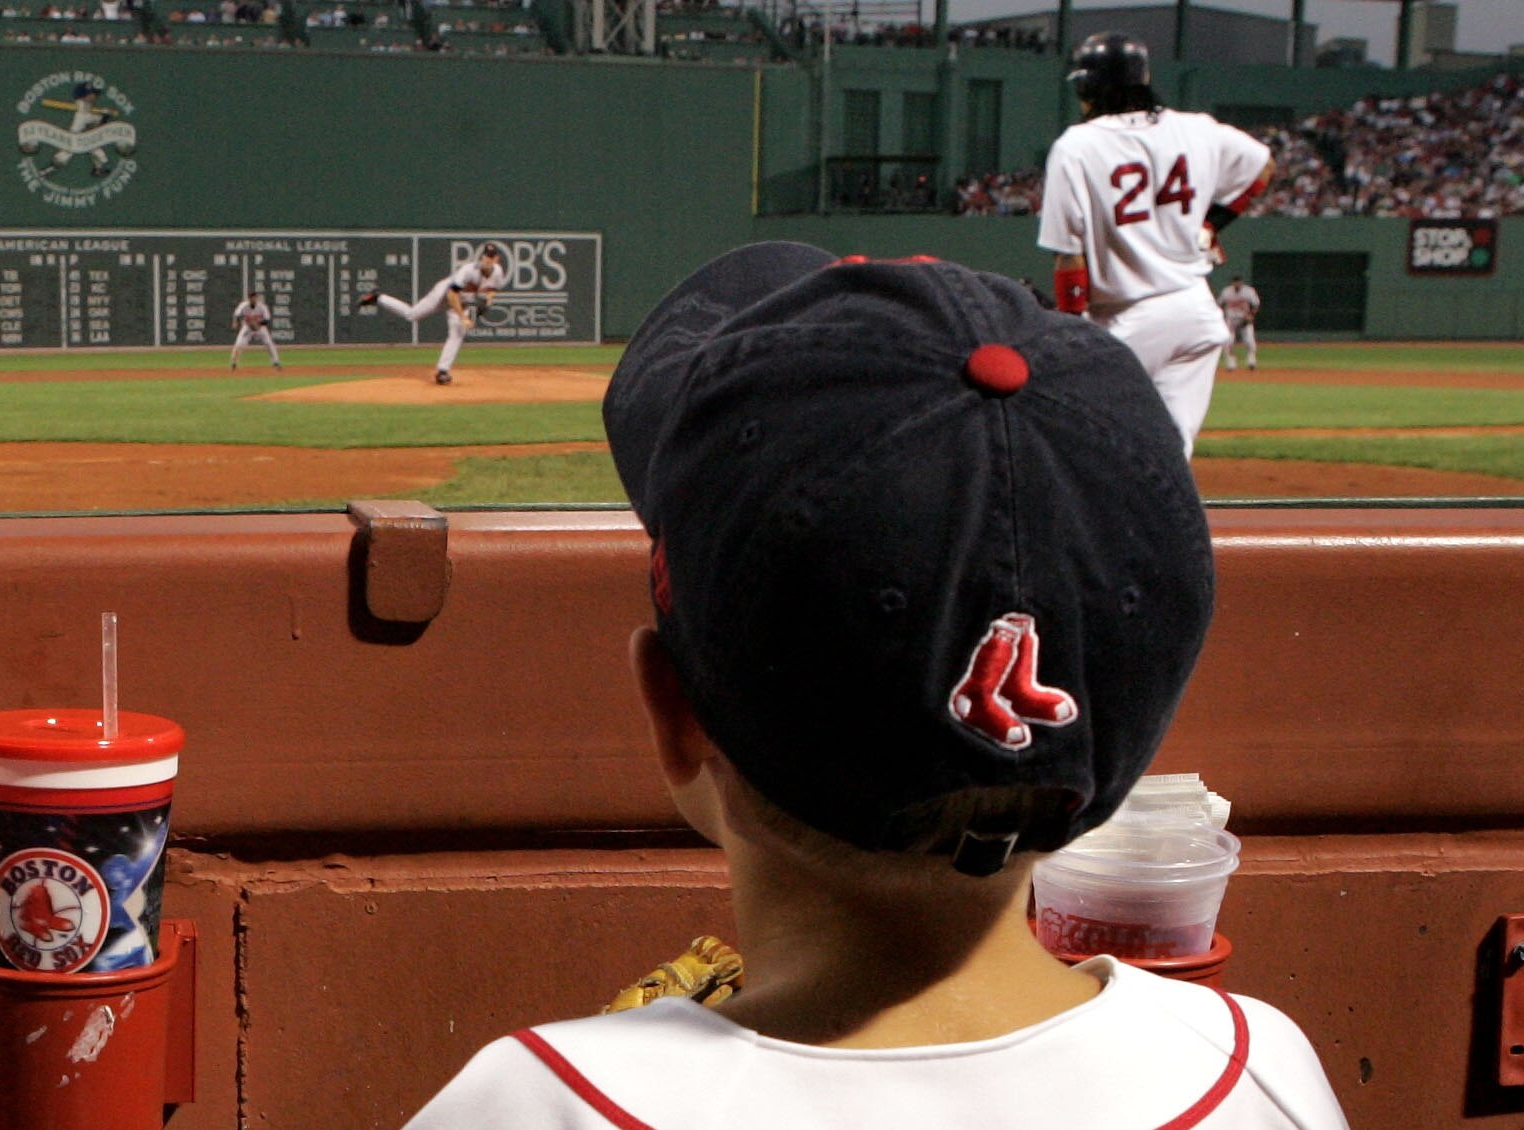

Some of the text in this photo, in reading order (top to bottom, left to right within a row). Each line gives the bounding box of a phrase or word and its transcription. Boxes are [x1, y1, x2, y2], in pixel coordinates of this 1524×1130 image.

[16, 71, 135, 115] BOSTON RED SOX
[1110, 154, 1196, 226] 24
[74, 240, 130, 251] LEAGUE
[225, 240, 349, 252] NATIONAL LEAGUE
[1413, 227, 1467, 248] STOP
[1413, 248, 1468, 267] SHOP
[0, 859, 94, 896] BOSTON
[2, 935, 94, 968] RED SOX
